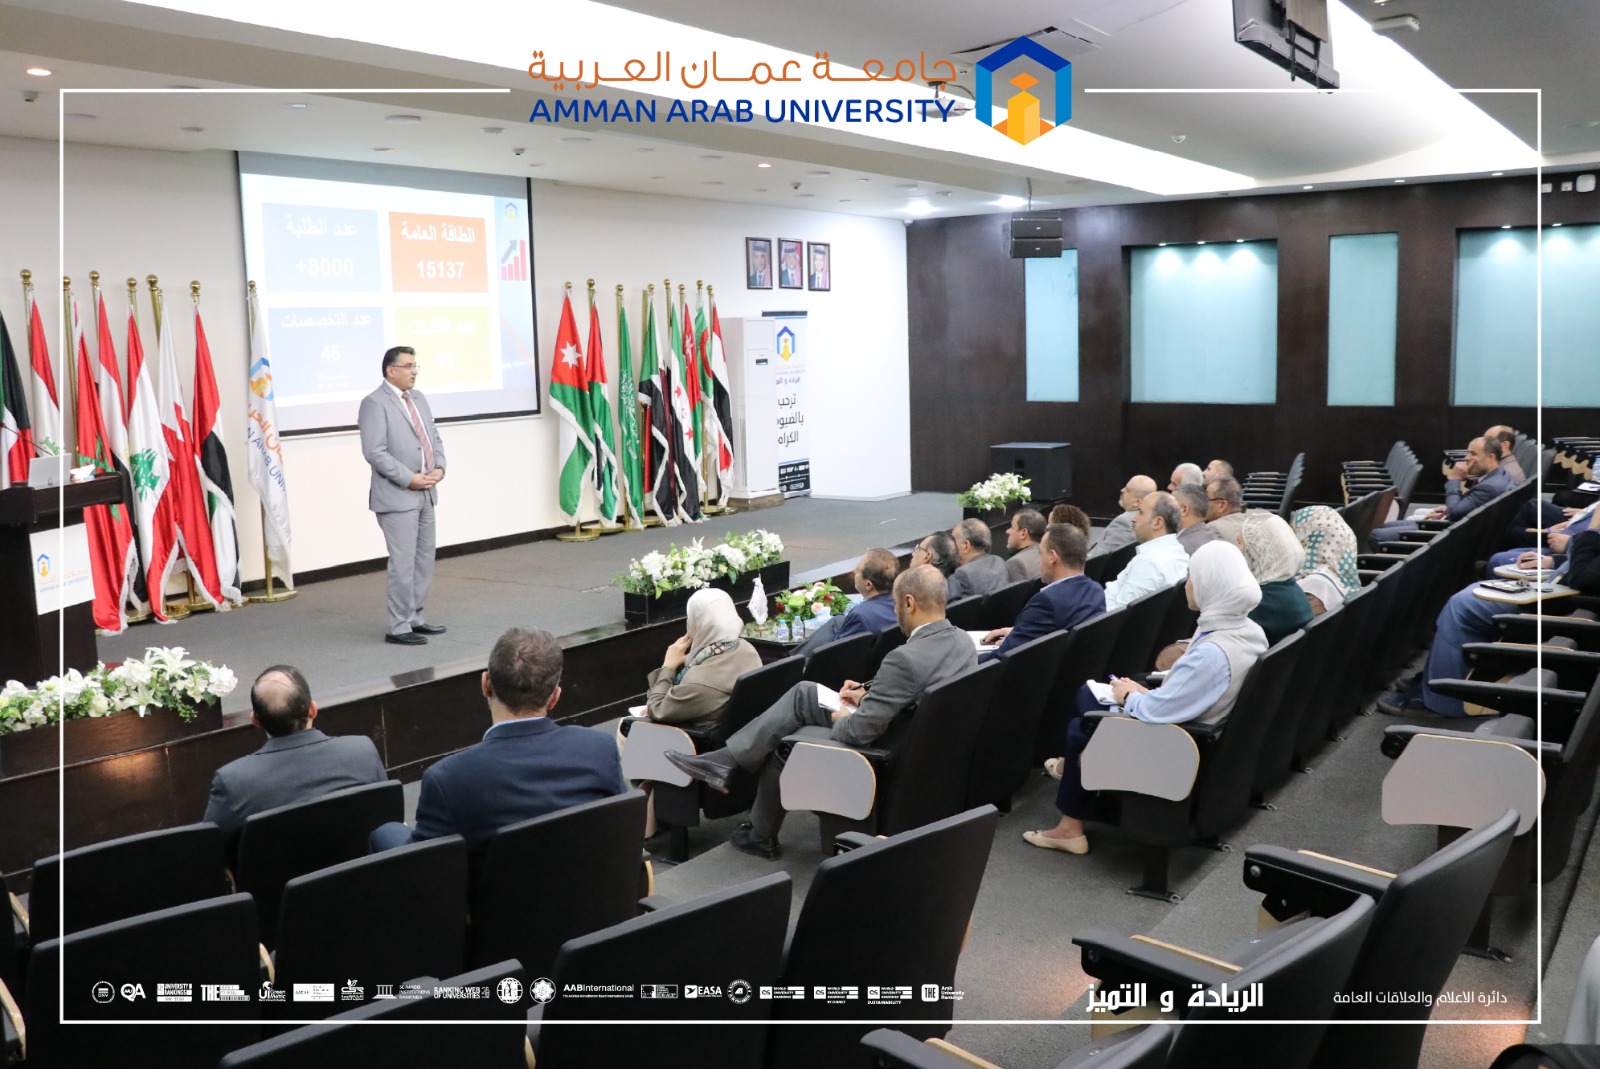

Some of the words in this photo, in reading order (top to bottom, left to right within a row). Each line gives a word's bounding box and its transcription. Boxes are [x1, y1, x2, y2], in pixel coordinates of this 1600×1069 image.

[400, 220, 437, 242] العامة
[440, 224, 476, 244] الطاقة
[415, 260, 465, 280] 15137
[320, 344, 341, 362] 46
